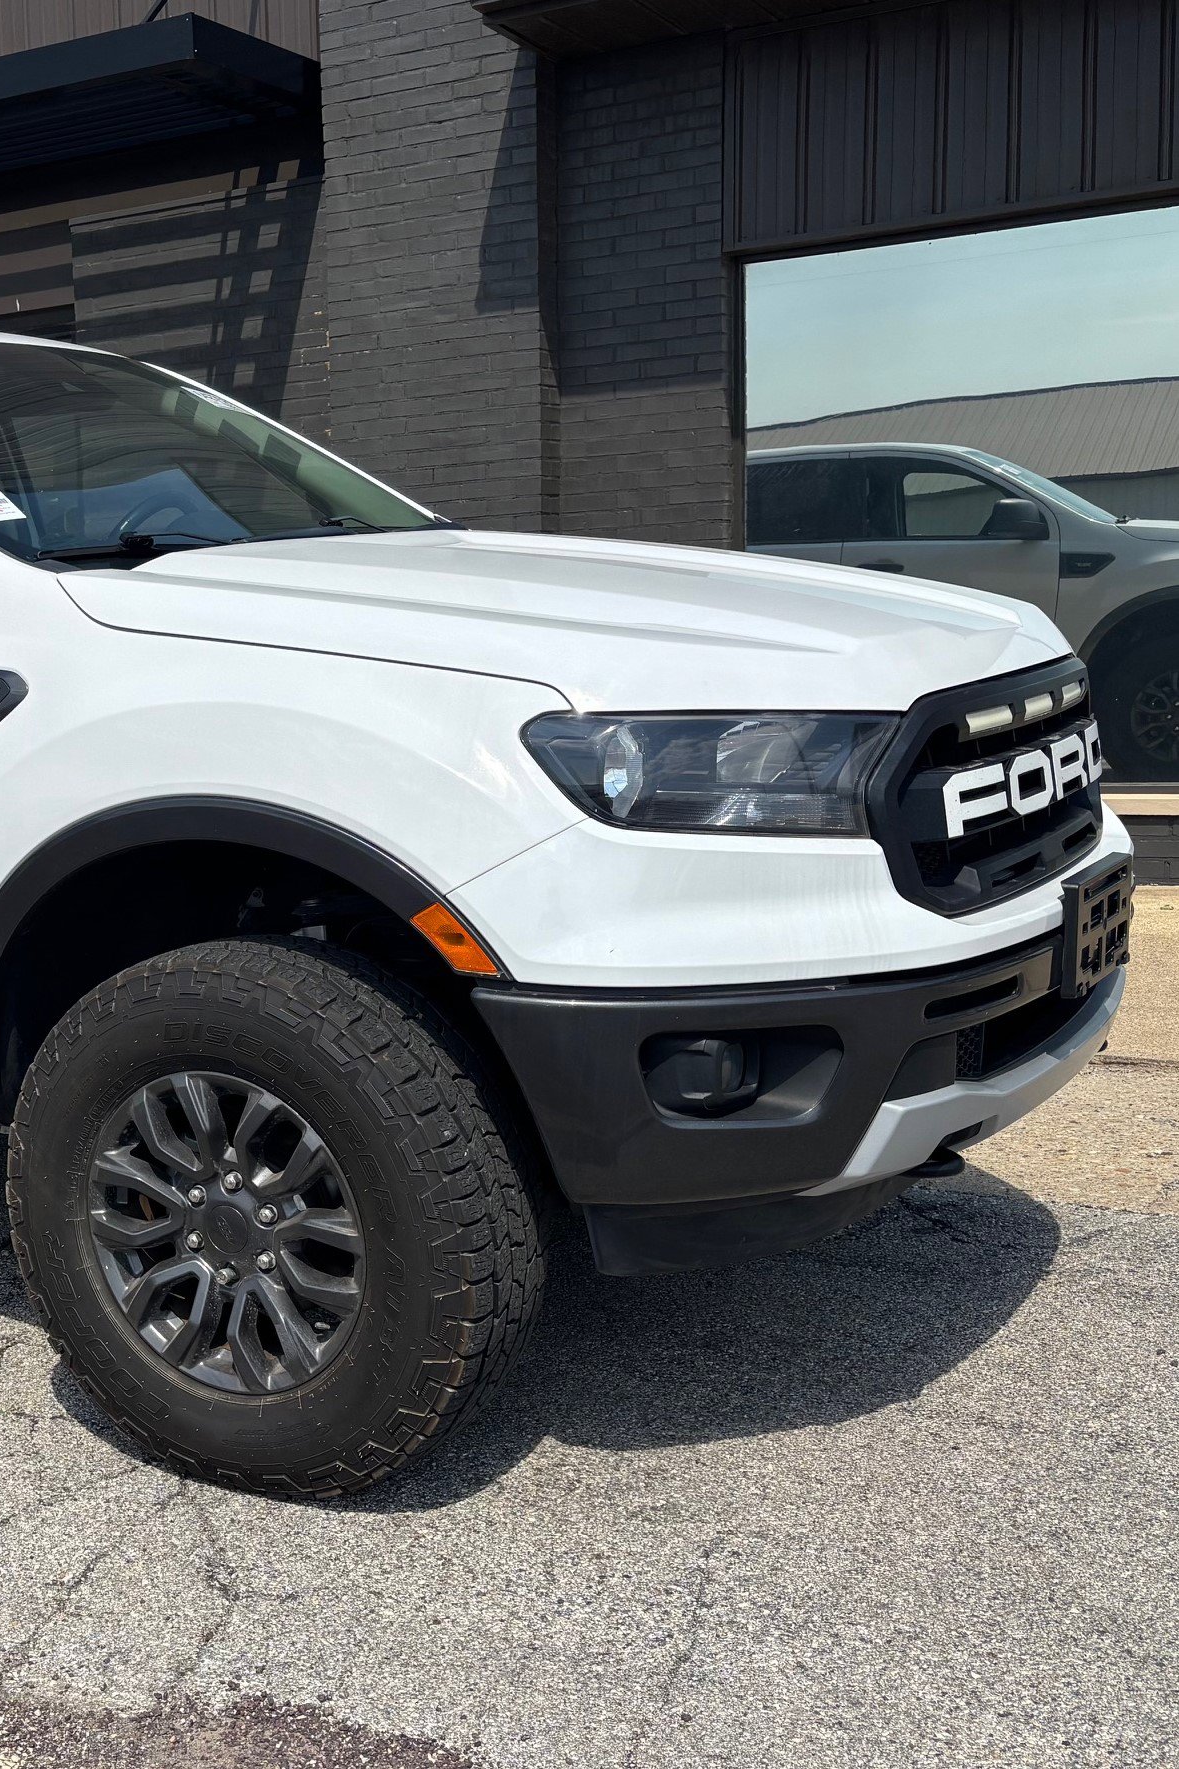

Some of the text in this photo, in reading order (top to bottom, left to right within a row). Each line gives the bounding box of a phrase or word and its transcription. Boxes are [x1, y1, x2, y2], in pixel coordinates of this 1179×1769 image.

[942, 719, 1103, 838] FORD
[163, 1021, 398, 1223] DISCOVERER
[41, 1232, 171, 1421] COOPER
